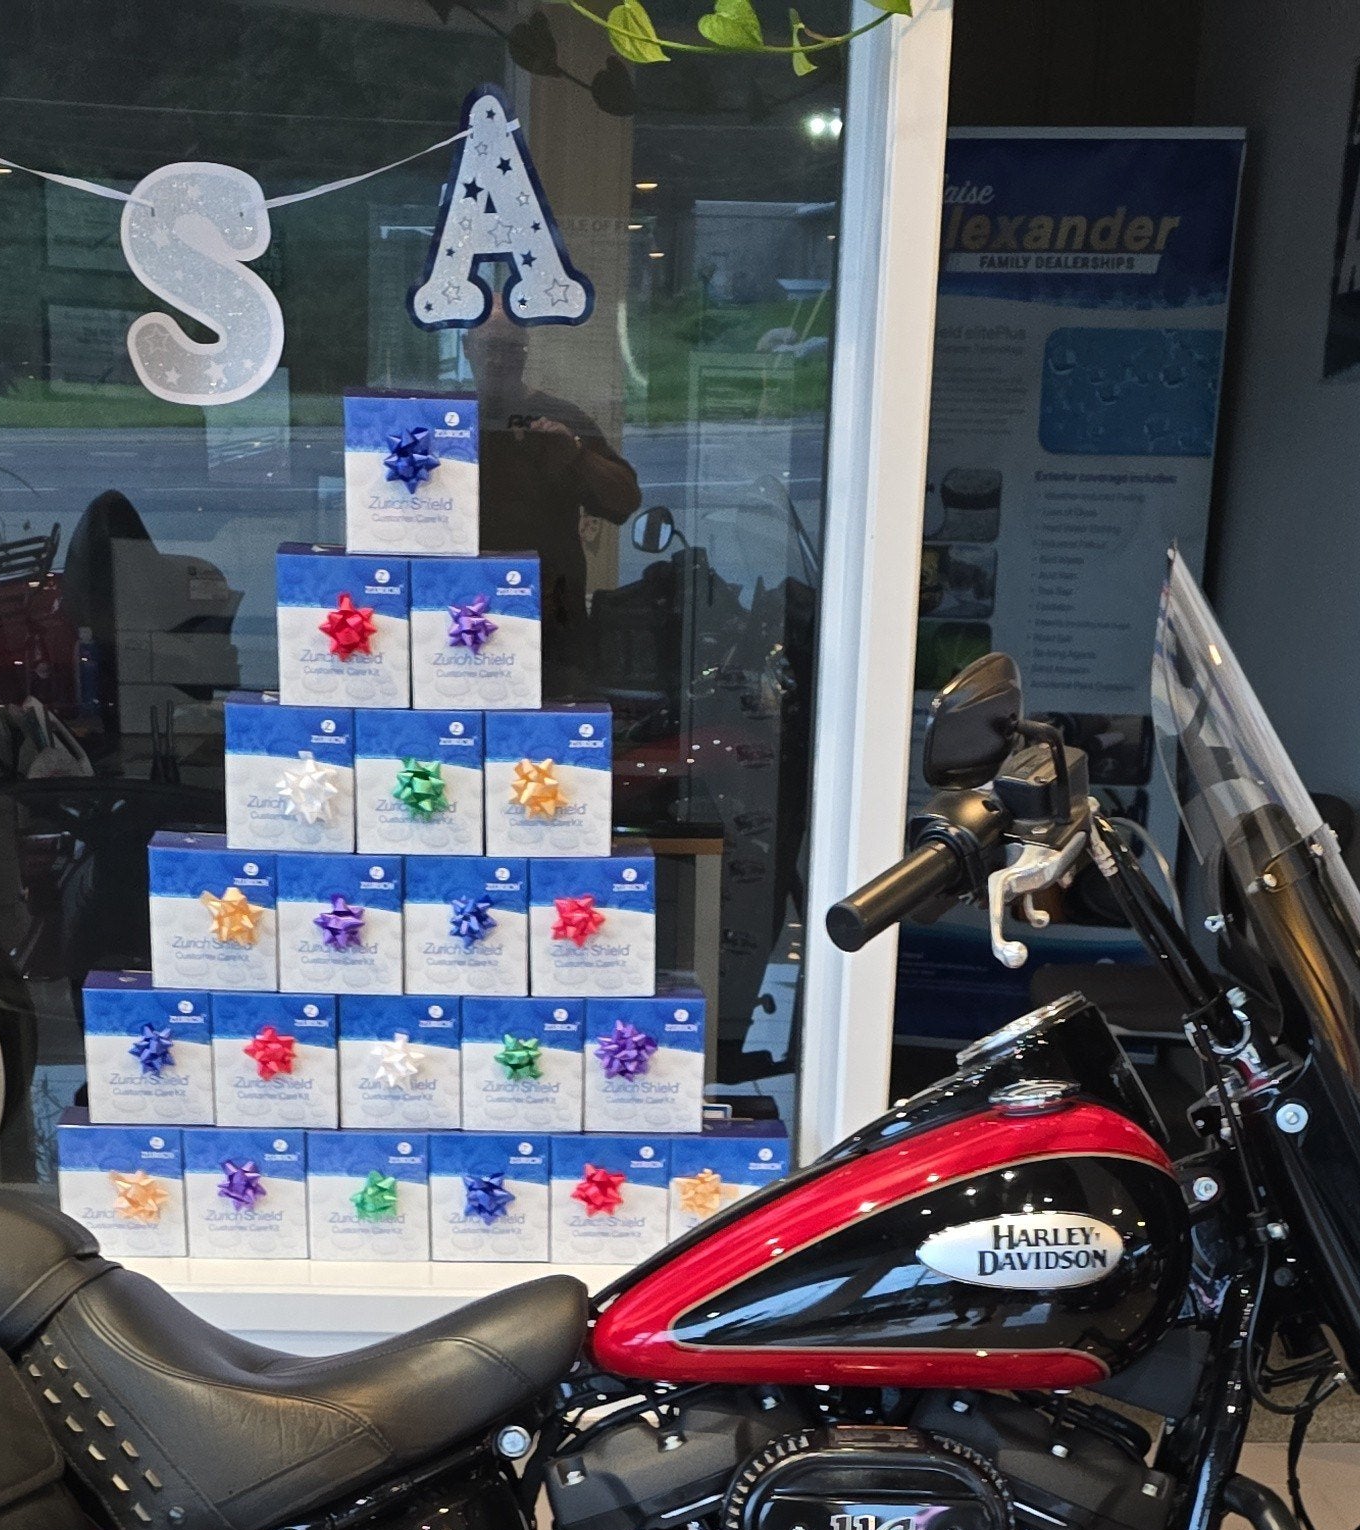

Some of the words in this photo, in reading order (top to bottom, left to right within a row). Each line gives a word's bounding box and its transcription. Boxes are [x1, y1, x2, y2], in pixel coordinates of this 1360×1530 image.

[944, 205, 1181, 251] lexander
[979, 255, 1032, 269] FAMILY
[1035, 255, 1136, 270] DEALERSHIPS
[977, 1249, 1108, 1276] DAVIDSON
